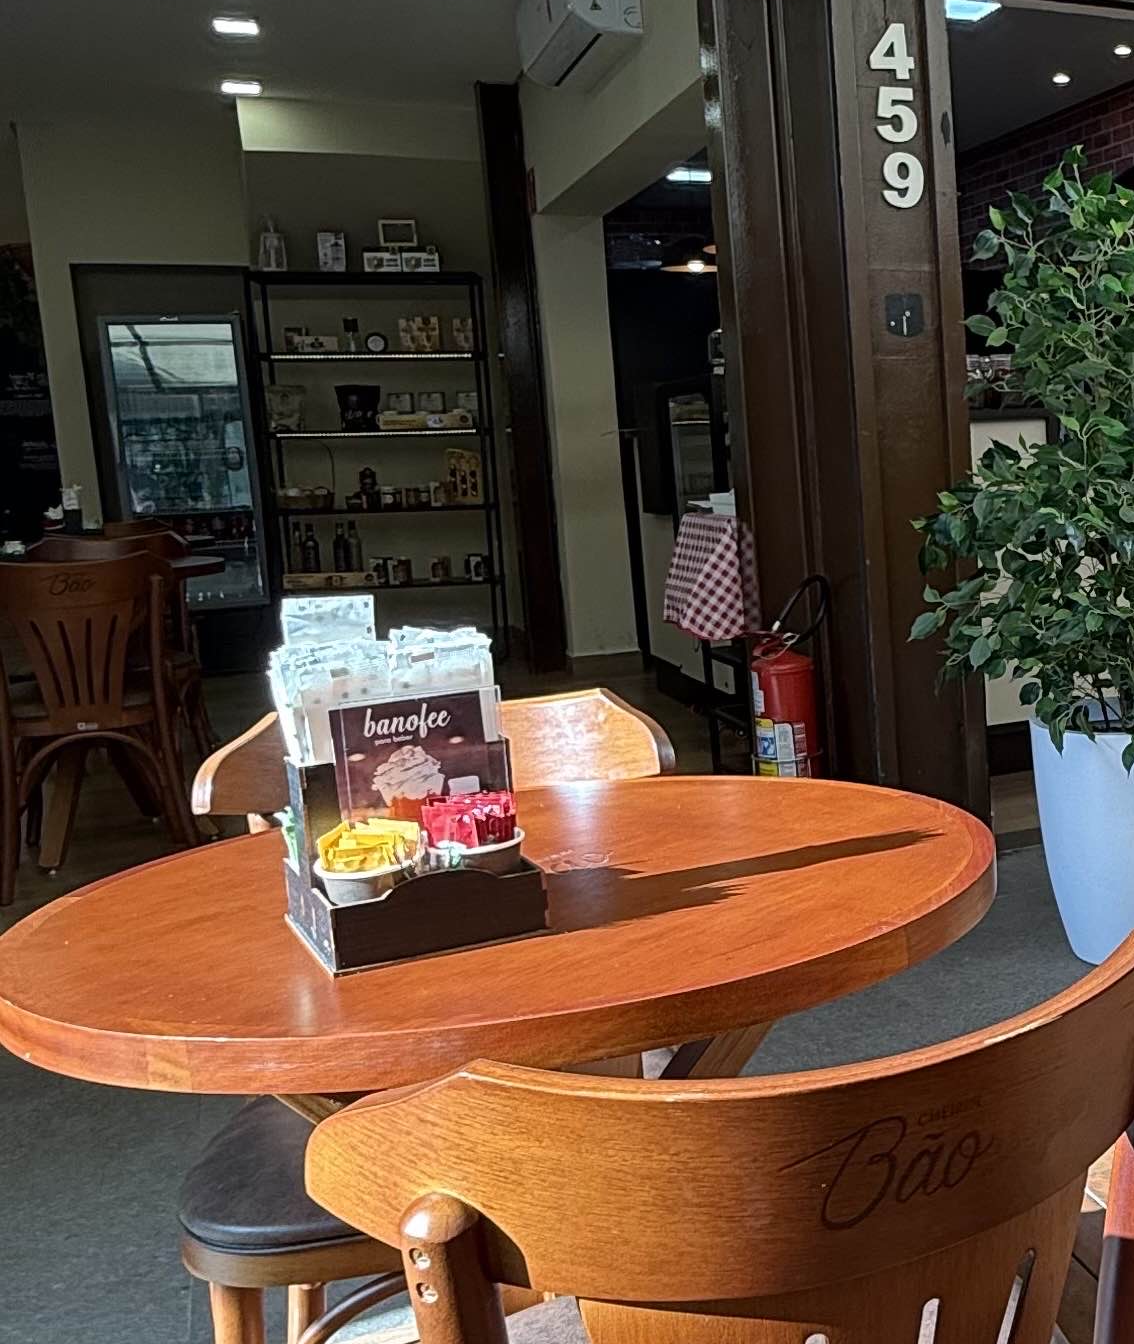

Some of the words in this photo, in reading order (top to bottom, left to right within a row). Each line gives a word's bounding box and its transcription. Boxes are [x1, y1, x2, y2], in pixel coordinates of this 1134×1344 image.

[869, 23, 925, 209] 459
[363, 703, 452, 738] banofee
[780, 1115, 995, 1231] Bão
